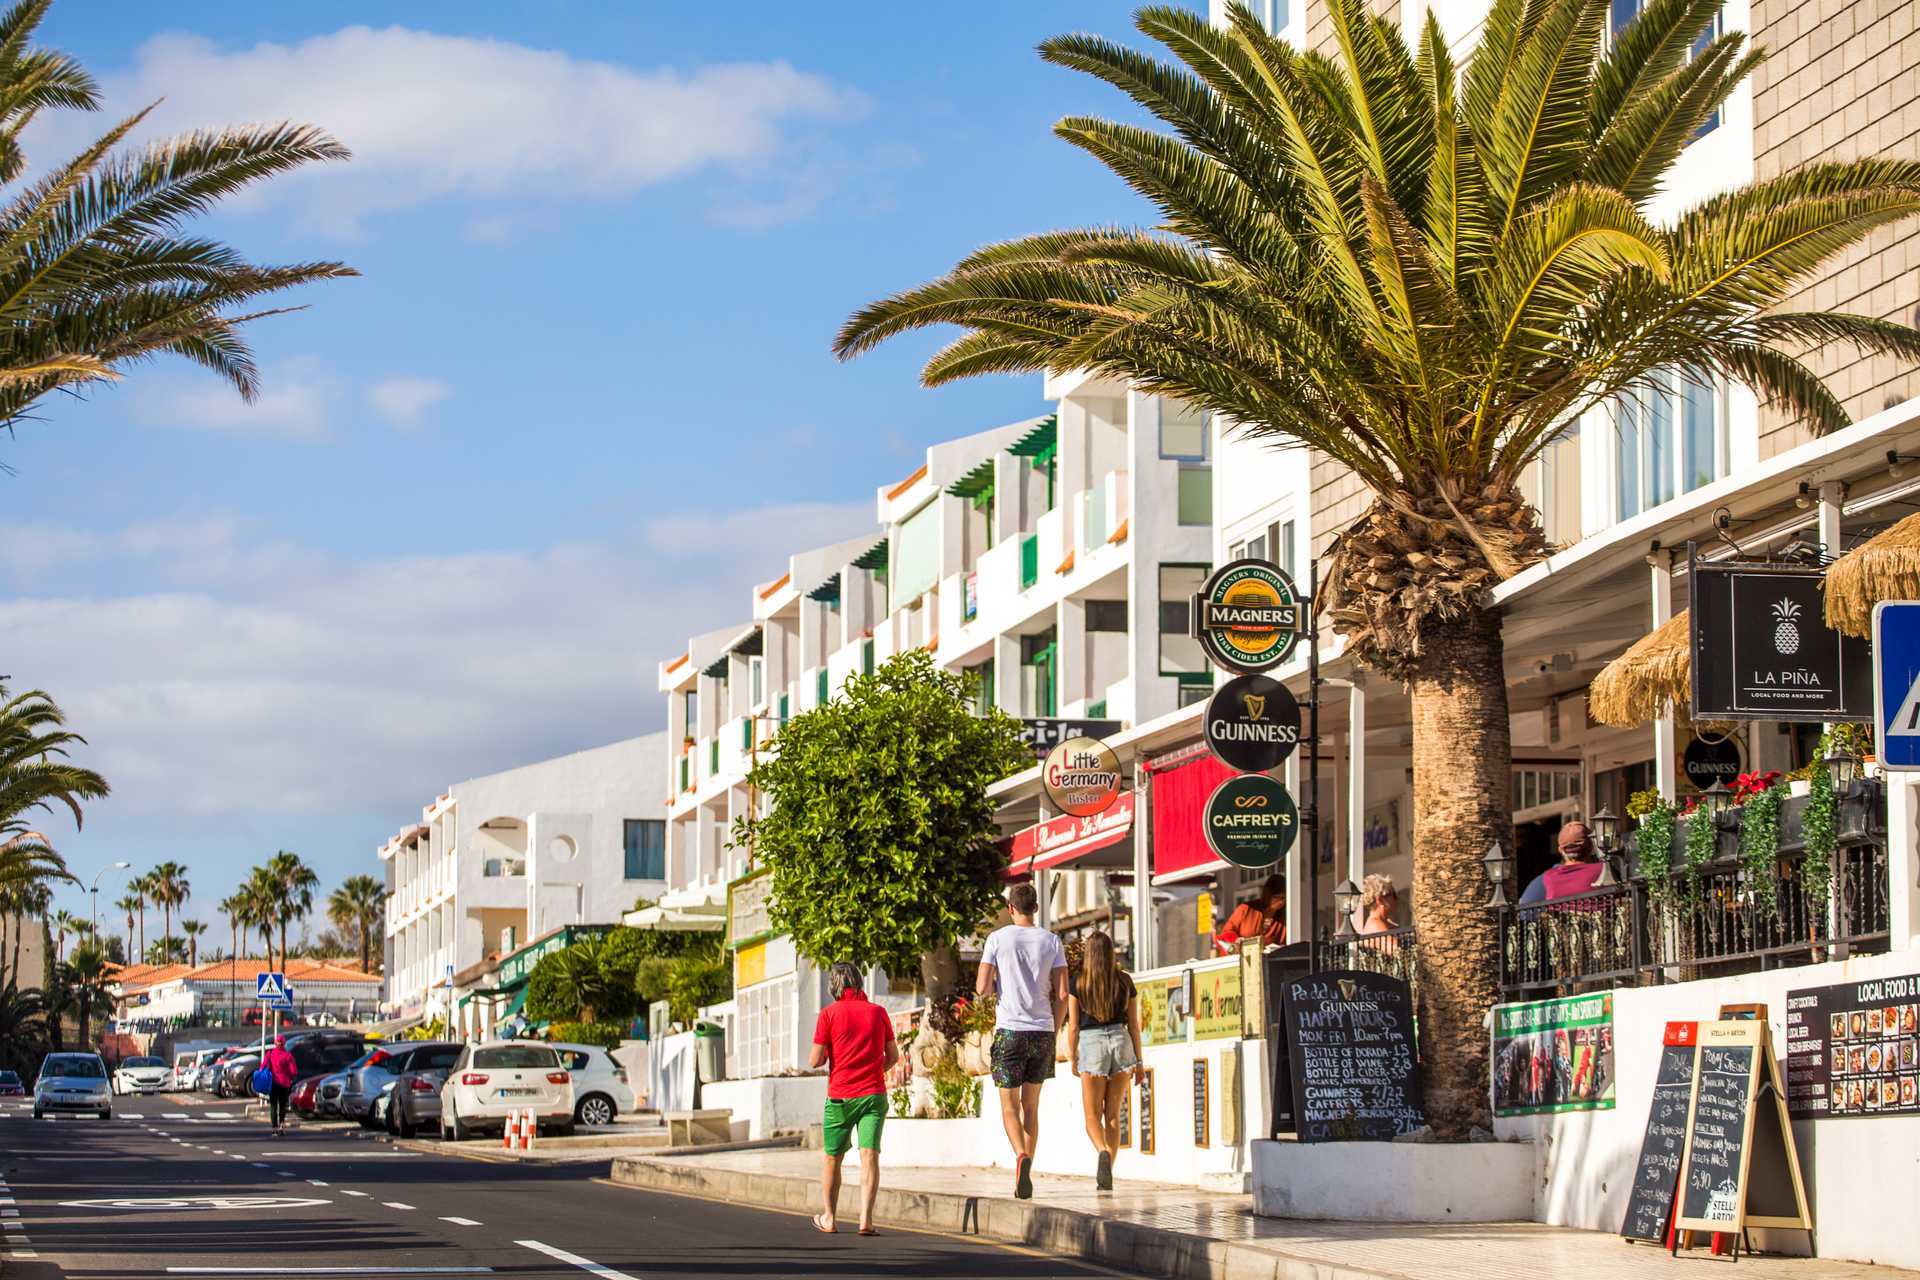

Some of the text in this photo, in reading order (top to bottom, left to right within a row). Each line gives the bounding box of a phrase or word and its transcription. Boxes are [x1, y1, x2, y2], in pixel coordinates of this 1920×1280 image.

[1217, 570, 1288, 598] MAGNERS ORIGINAL
[1211, 607, 1294, 624] MAGNERS
[1231, 650, 1258, 661] CIDER
[1754, 668, 1821, 685] LA PIÑA
[1211, 719, 1297, 743] GUINNESS
[1063, 748, 1101, 770] Little
[1687, 761, 1737, 774] GUINNESS
[1049, 764, 1116, 790] Germany
[1067, 792, 1100, 806] Bistro
[1212, 813, 1292, 827] CAFFREY'S
[1858, 977, 1916, 1002] LOCAL FOOD &
[1320, 1000, 1378, 1012] GUINNESS
[1299, 1010, 1398, 1028] HAPPY HOURS
[1304, 1047, 1338, 1058] BOTTLE
[1341, 1047, 1353, 1057] OF
[1305, 1059, 1339, 1069] BOTTLE
[1341, 1059, 1353, 1068] OF
[1356, 1059, 1382, 1068] WINE
[1306, 1068, 1340, 1078] BOTTLE
[1343, 1068, 1354, 1078] OF
[1305, 1086, 1363, 1099] GUINNESS
